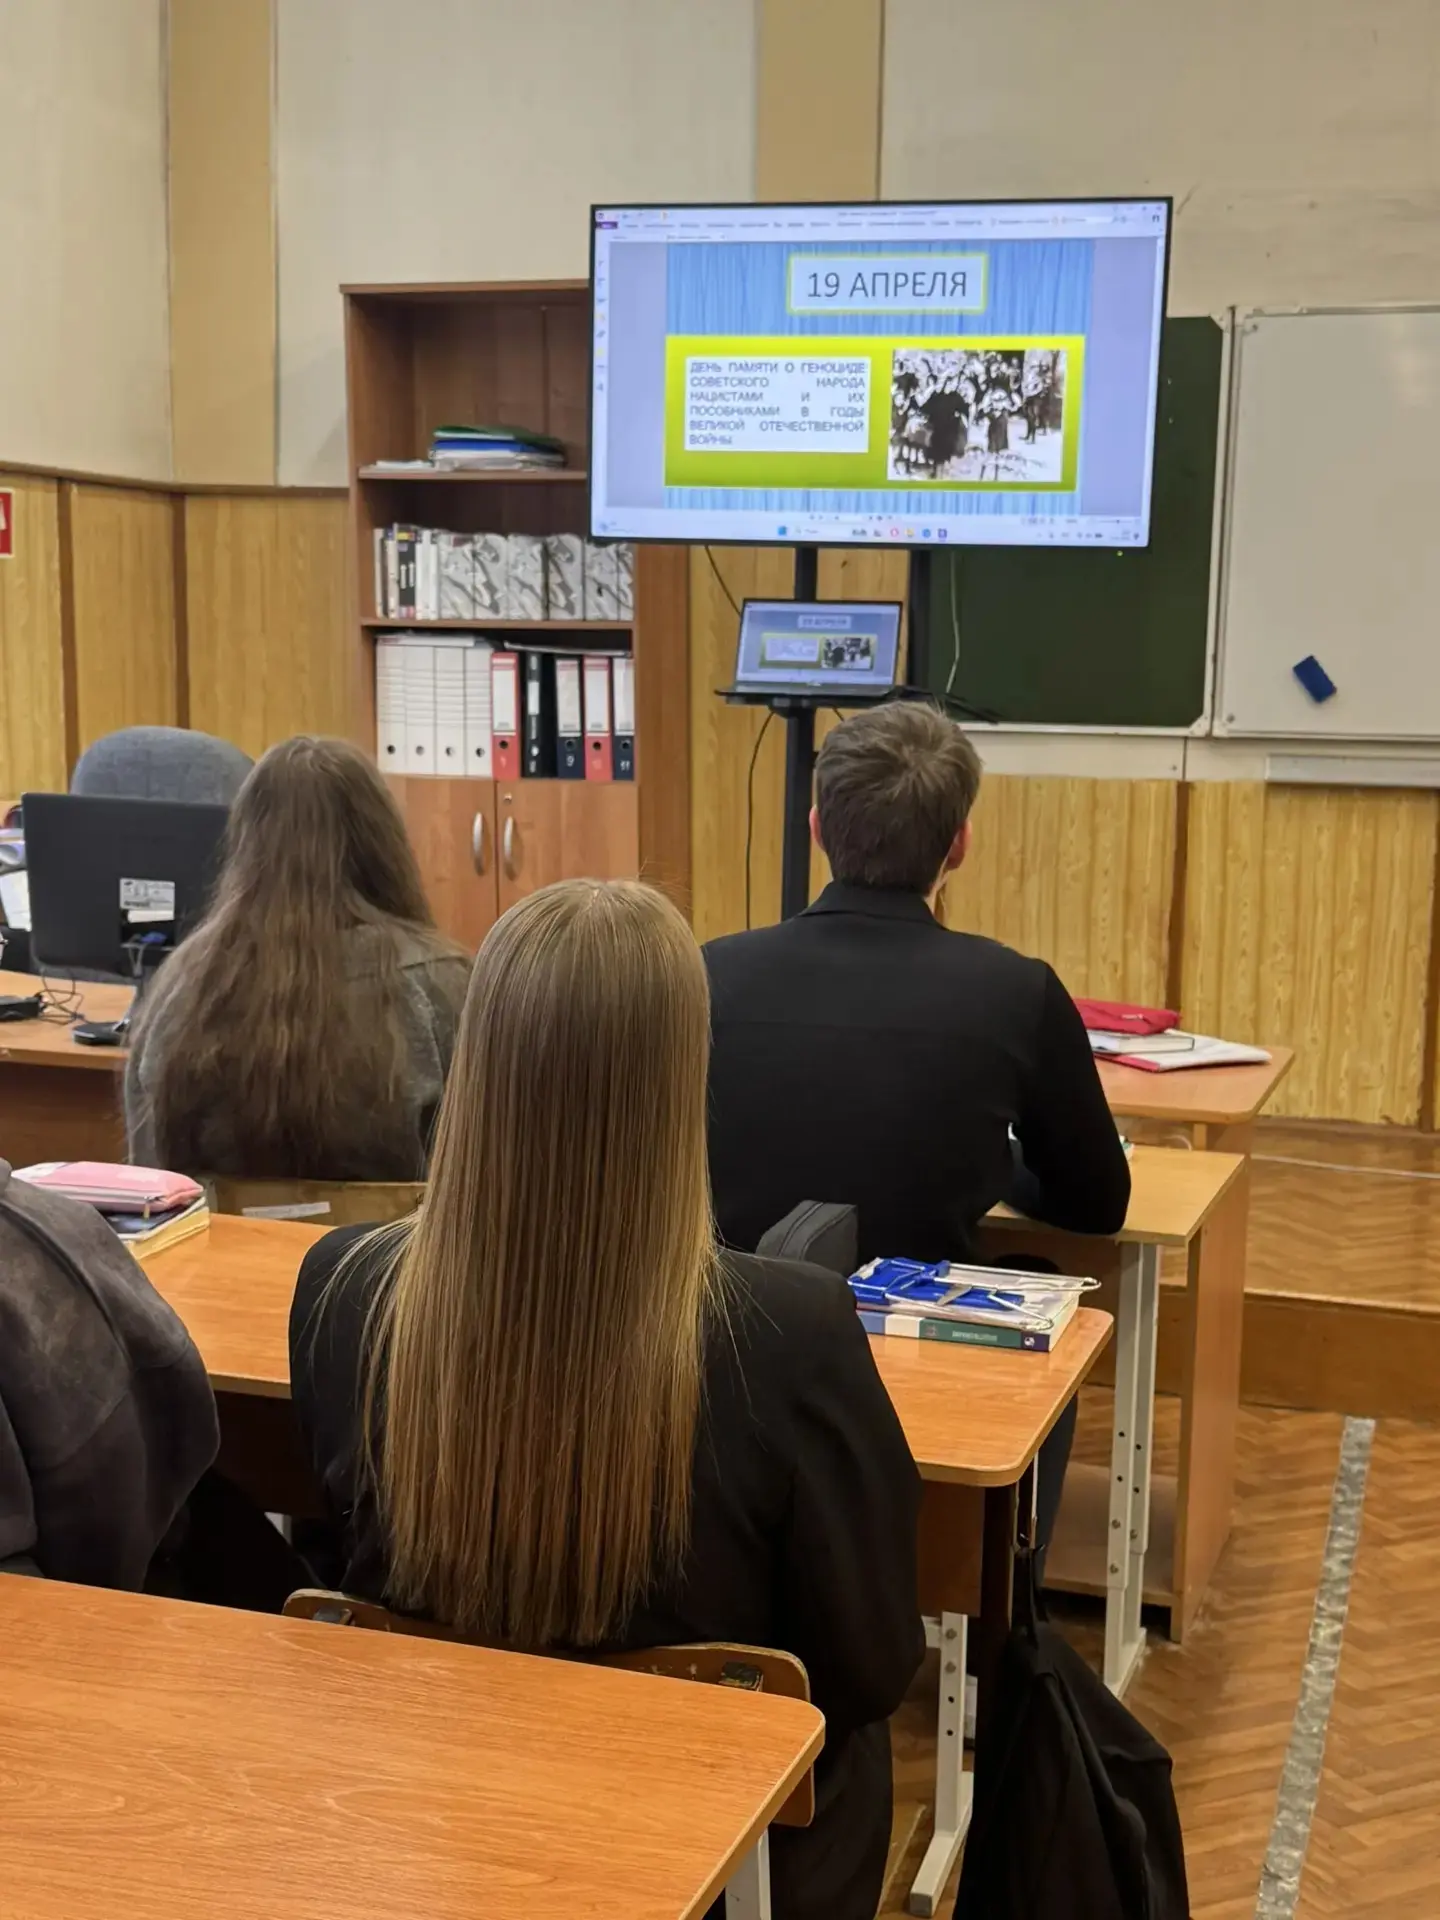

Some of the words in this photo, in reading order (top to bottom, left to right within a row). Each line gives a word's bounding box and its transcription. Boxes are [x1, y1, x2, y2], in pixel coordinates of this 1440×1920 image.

[807, 271, 840, 298] 19
[849, 271, 967, 298] АПРЕЛЯ
[690, 362, 722, 374] ДЕНЬ
[728, 362, 778, 374] ПАМЯТИ
[784, 362, 795, 374] О
[801, 362, 865, 374] ГЕНОЦИДЕ
[690, 377, 769, 388] СОВЕТСКОГО
[816, 377, 865, 389] НАРОДА
[690, 391, 763, 403] НАЦИСТАМИ
[801, 392, 810, 402] И
[848, 393, 865, 403] ИХ
[690, 406, 780, 417] ПОСОБНИКАМИ
[801, 406, 809, 417] В
[830, 407, 865, 418] ГОДЫ
[689, 420, 745, 432] ВЕЛИКОЙ
[759, 420, 864, 432] ОТЕЧЕСТВЕННОЙ
[689, 434, 733, 445] ВОЙНЫ
